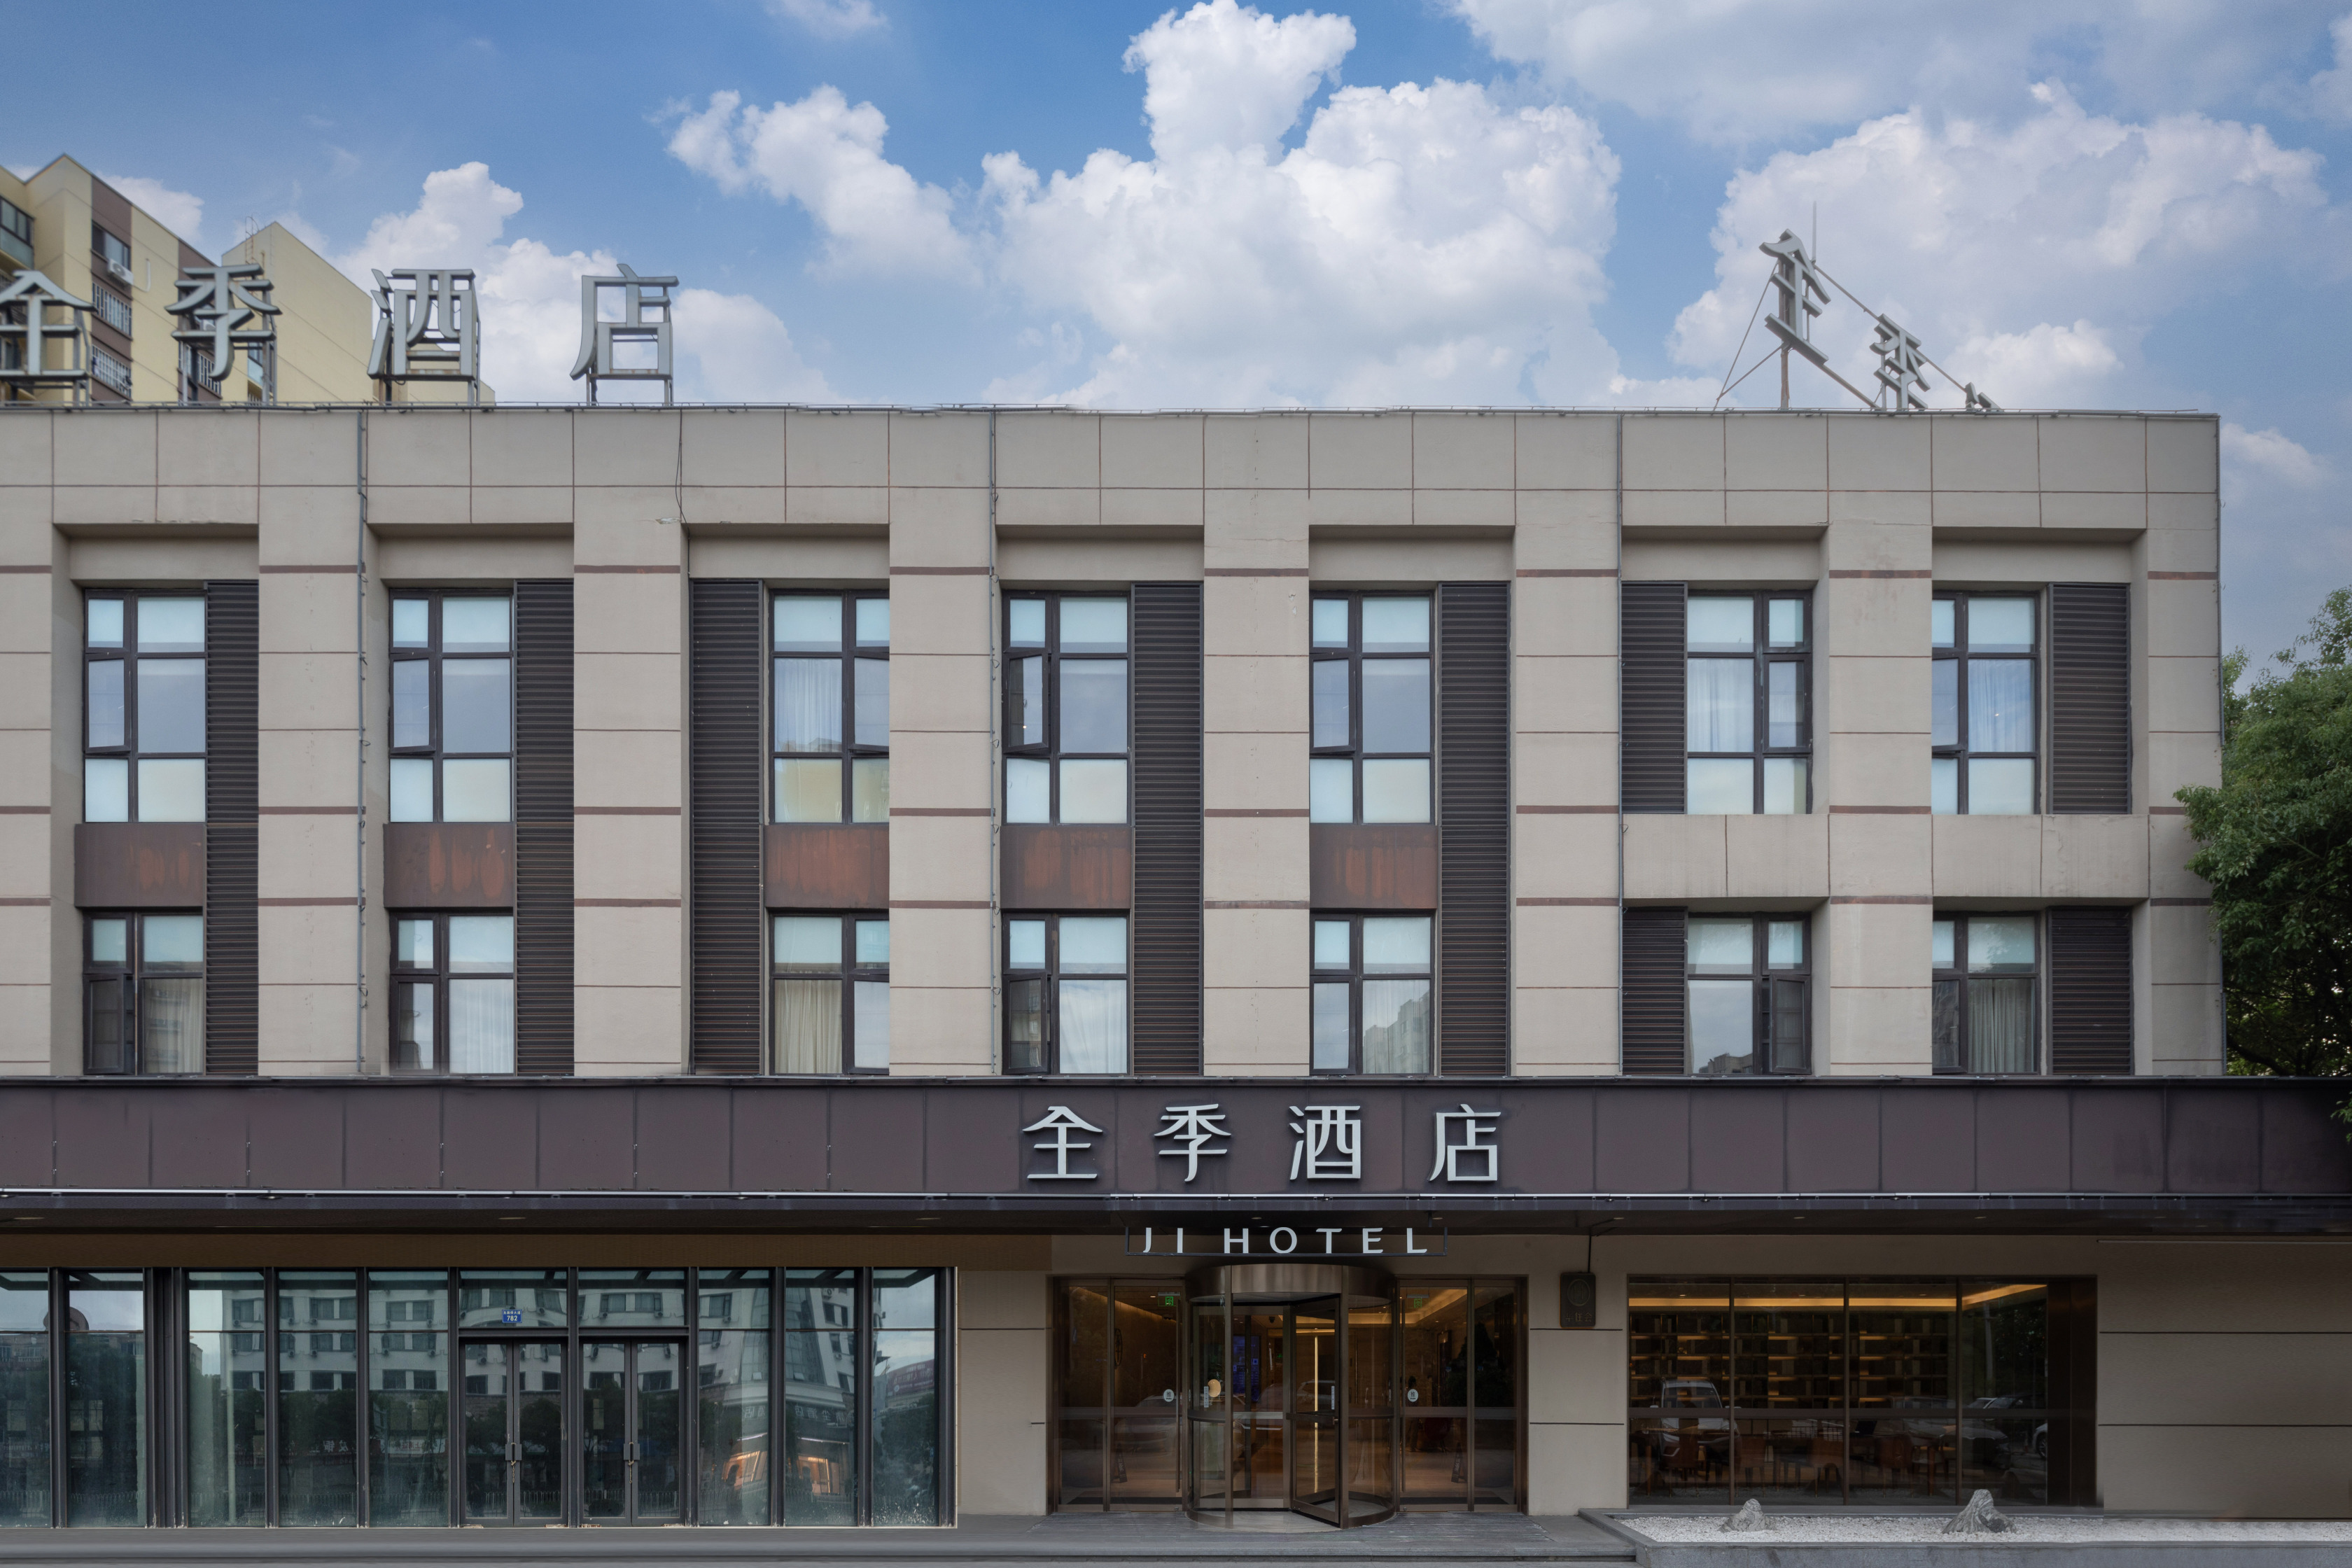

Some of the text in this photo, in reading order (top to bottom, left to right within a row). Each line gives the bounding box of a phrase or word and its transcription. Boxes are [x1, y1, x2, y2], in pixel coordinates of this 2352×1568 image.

[0, 263, 679, 382] 全季酒店
[1022, 1103, 1502, 1183] 全季酒店
[1142, 1226, 1427, 1254] JI HOTEL
